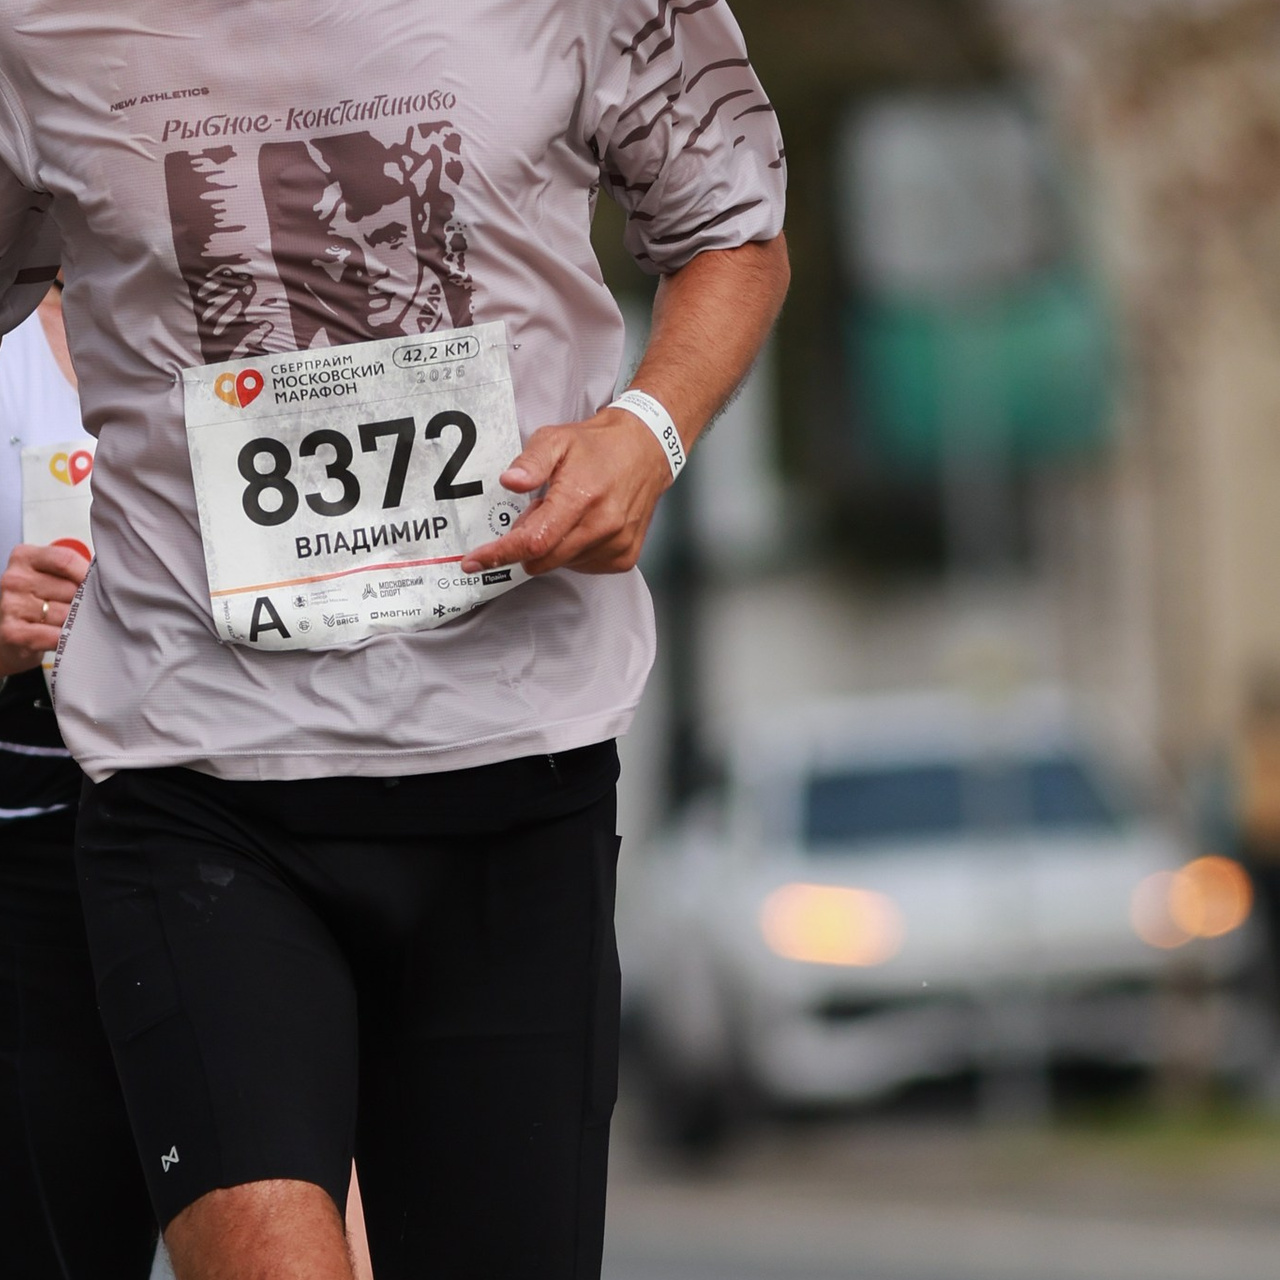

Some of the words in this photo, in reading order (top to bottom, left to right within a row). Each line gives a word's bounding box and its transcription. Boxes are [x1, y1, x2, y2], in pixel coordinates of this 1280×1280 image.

[110, 97, 137, 112] NEW
[140, 87, 210, 104] ATHLETICS
[403, 346, 438, 362] 42,2
[445, 341, 470, 357] КМ
[271, 355, 353, 375] СБЕРПРАЙМ
[272, 360, 385, 390] МОСКОВСКИЙ
[274, 382, 358, 404] МАРАФОН
[662, 426, 683, 470] 8372
[236, 409, 485, 527] 8372
[498, 512, 511, 527] 9
[296, 516, 449, 559] ВЛАДИМИР
[378, 576, 424, 590] МОСКОВСКИЙ
[452, 577, 480, 587] СБЕР
[380, 588, 401, 598] СПОРТ
[336, 616, 360, 626] BRICS
